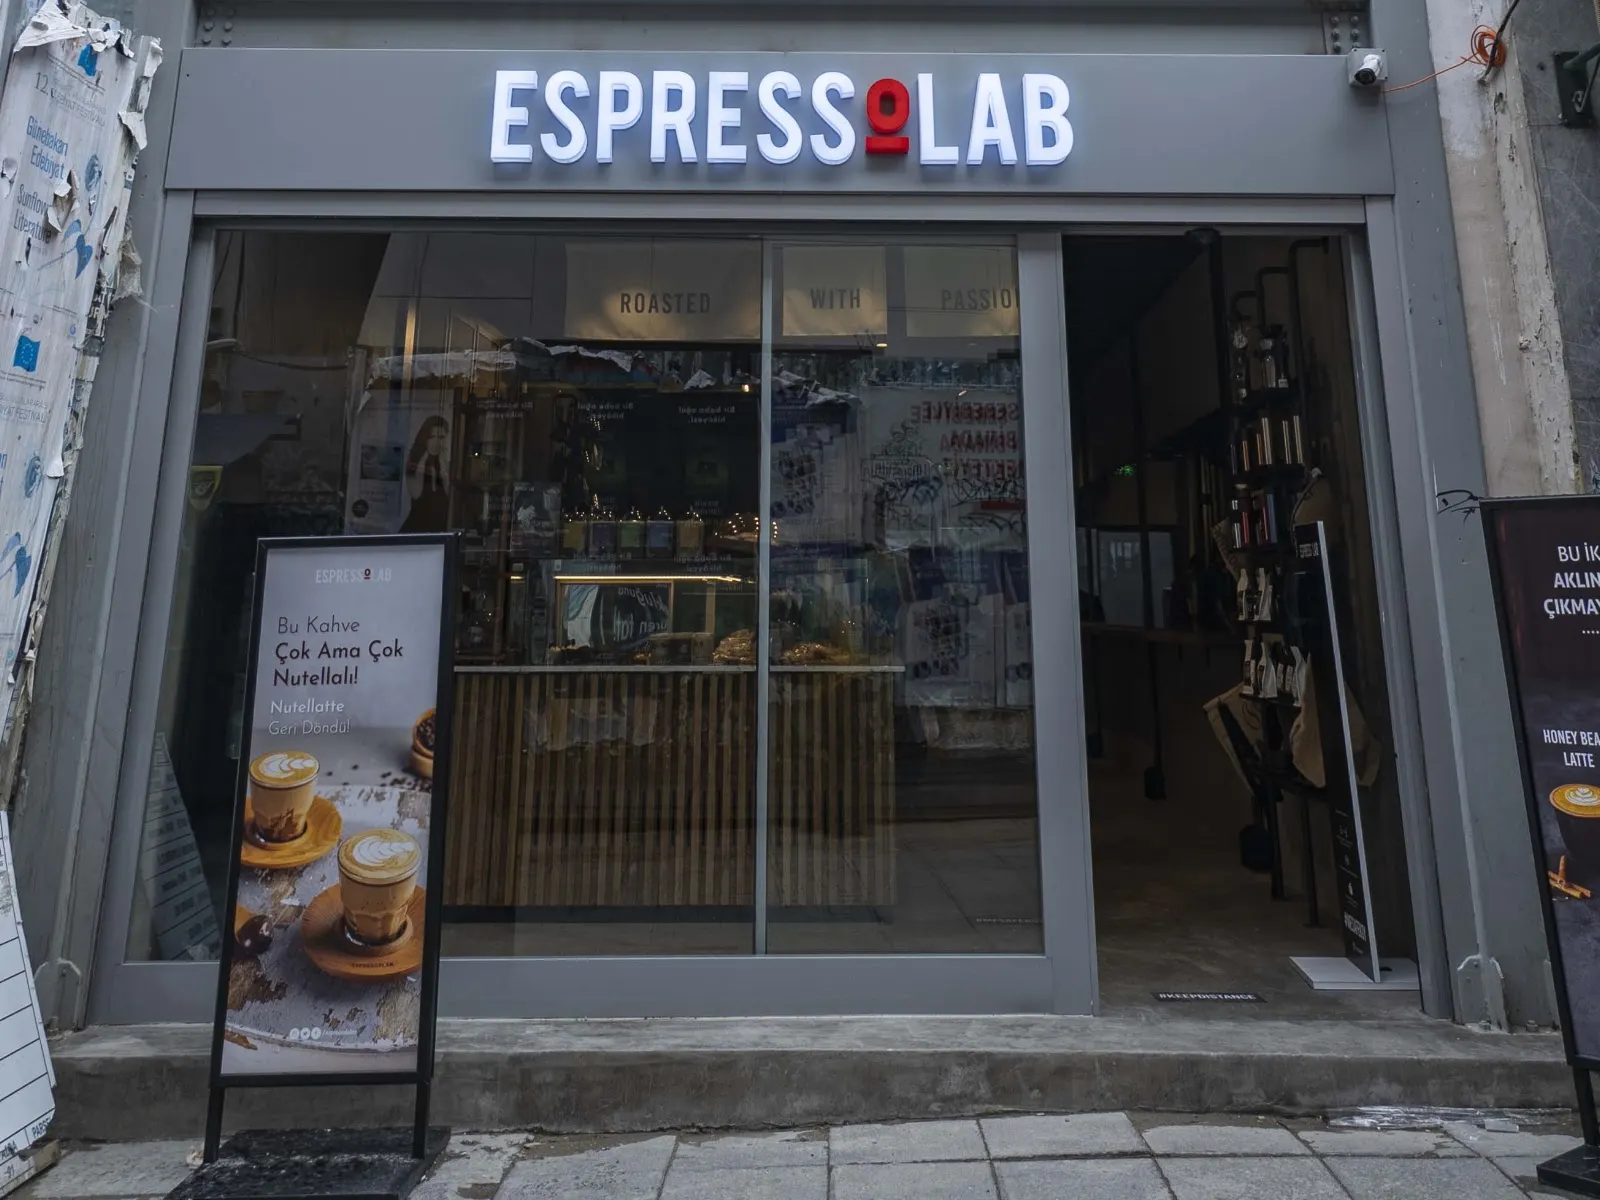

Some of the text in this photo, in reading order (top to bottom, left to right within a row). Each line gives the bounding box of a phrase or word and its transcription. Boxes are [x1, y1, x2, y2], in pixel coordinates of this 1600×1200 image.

[490, 70, 1074, 166] ESPRESSOLAB
[26, 115, 69, 157] Günebakan
[30, 145, 65, 180] Edebiyat
[17, 183, 49, 215] Sunflow
[620, 292, 711, 314] ROASTED
[810, 287, 862, 310] WITH
[1557, 545, 1580, 562] BU
[315, 568, 393, 584] ESPRESSOLAB
[277, 614, 361, 634] Bu Kahve
[275, 638, 404, 664] Çok Ama Çok
[273, 665, 359, 687] Nutellalı!
[270, 697, 345, 714] Nutellatte
[268, 719, 351, 735] Geri Döndü!
[1542, 729, 1577, 745] HONEY
[1563, 751, 1595, 768] LATTE
[1158, 992, 1257, 1000] #KEEPDISTANCE
